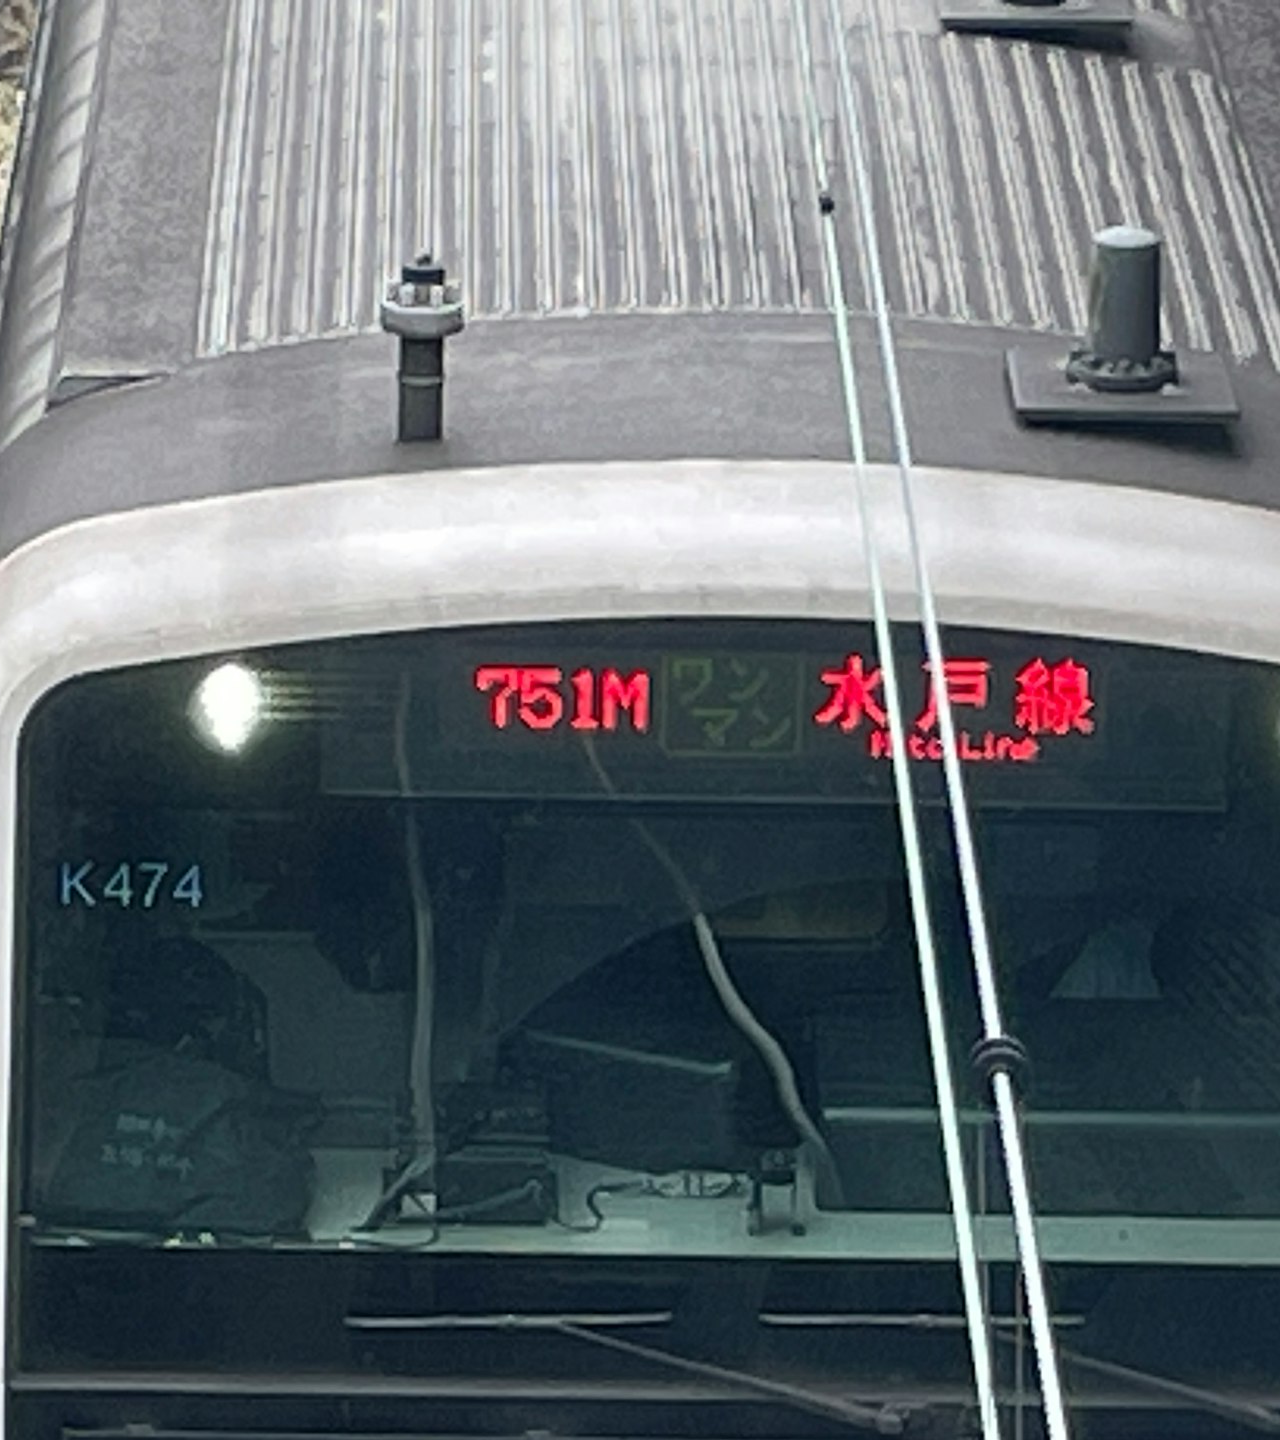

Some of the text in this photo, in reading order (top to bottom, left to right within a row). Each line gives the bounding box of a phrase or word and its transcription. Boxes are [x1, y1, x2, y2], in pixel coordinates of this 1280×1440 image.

[476, 667, 651, 730] 751M
[815, 655, 1095, 735] 水戸線
[960, 731, 1039, 760] Line
[60, 860, 202, 908] K474
